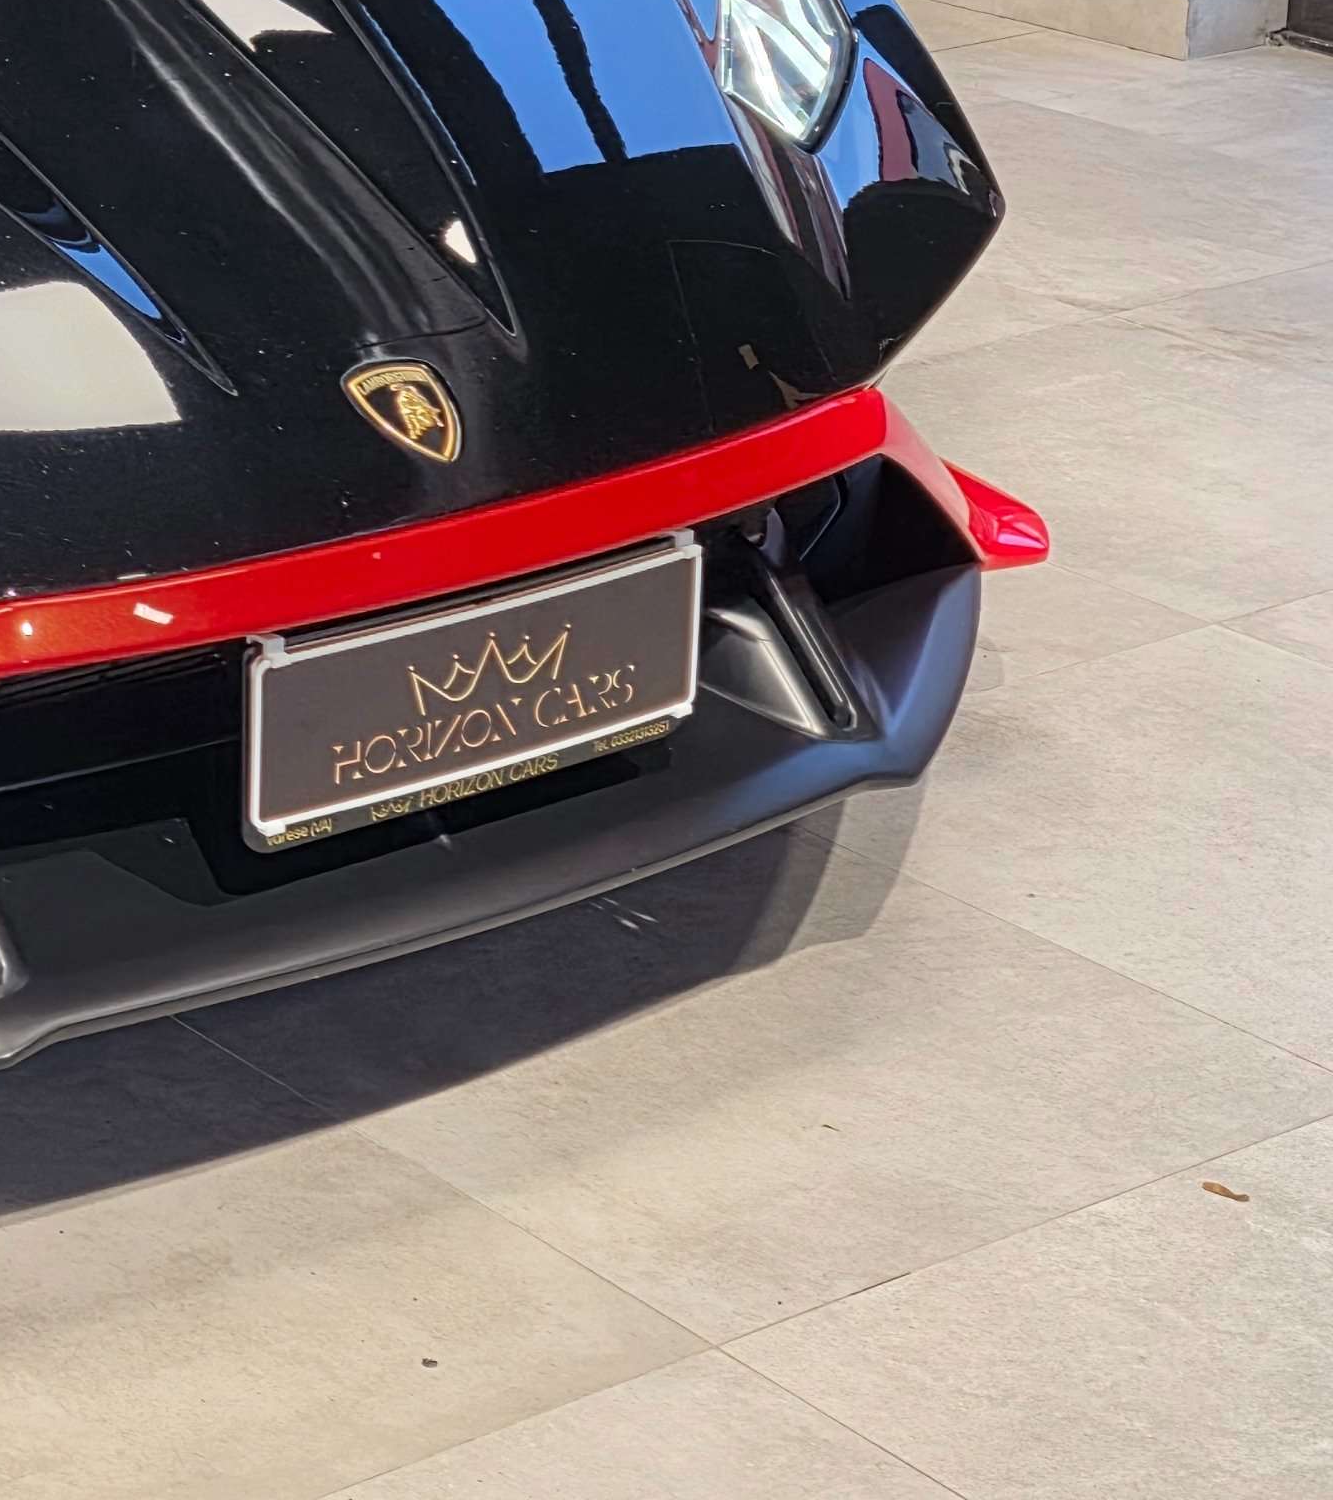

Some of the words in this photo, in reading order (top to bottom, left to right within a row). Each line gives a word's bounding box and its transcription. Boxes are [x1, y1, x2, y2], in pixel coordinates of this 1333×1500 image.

[332, 697, 522, 786] HORIZON
[534, 663, 636, 729] CARS
[419, 768, 505, 808] HORIZON
[508, 752, 560, 783] CARS
